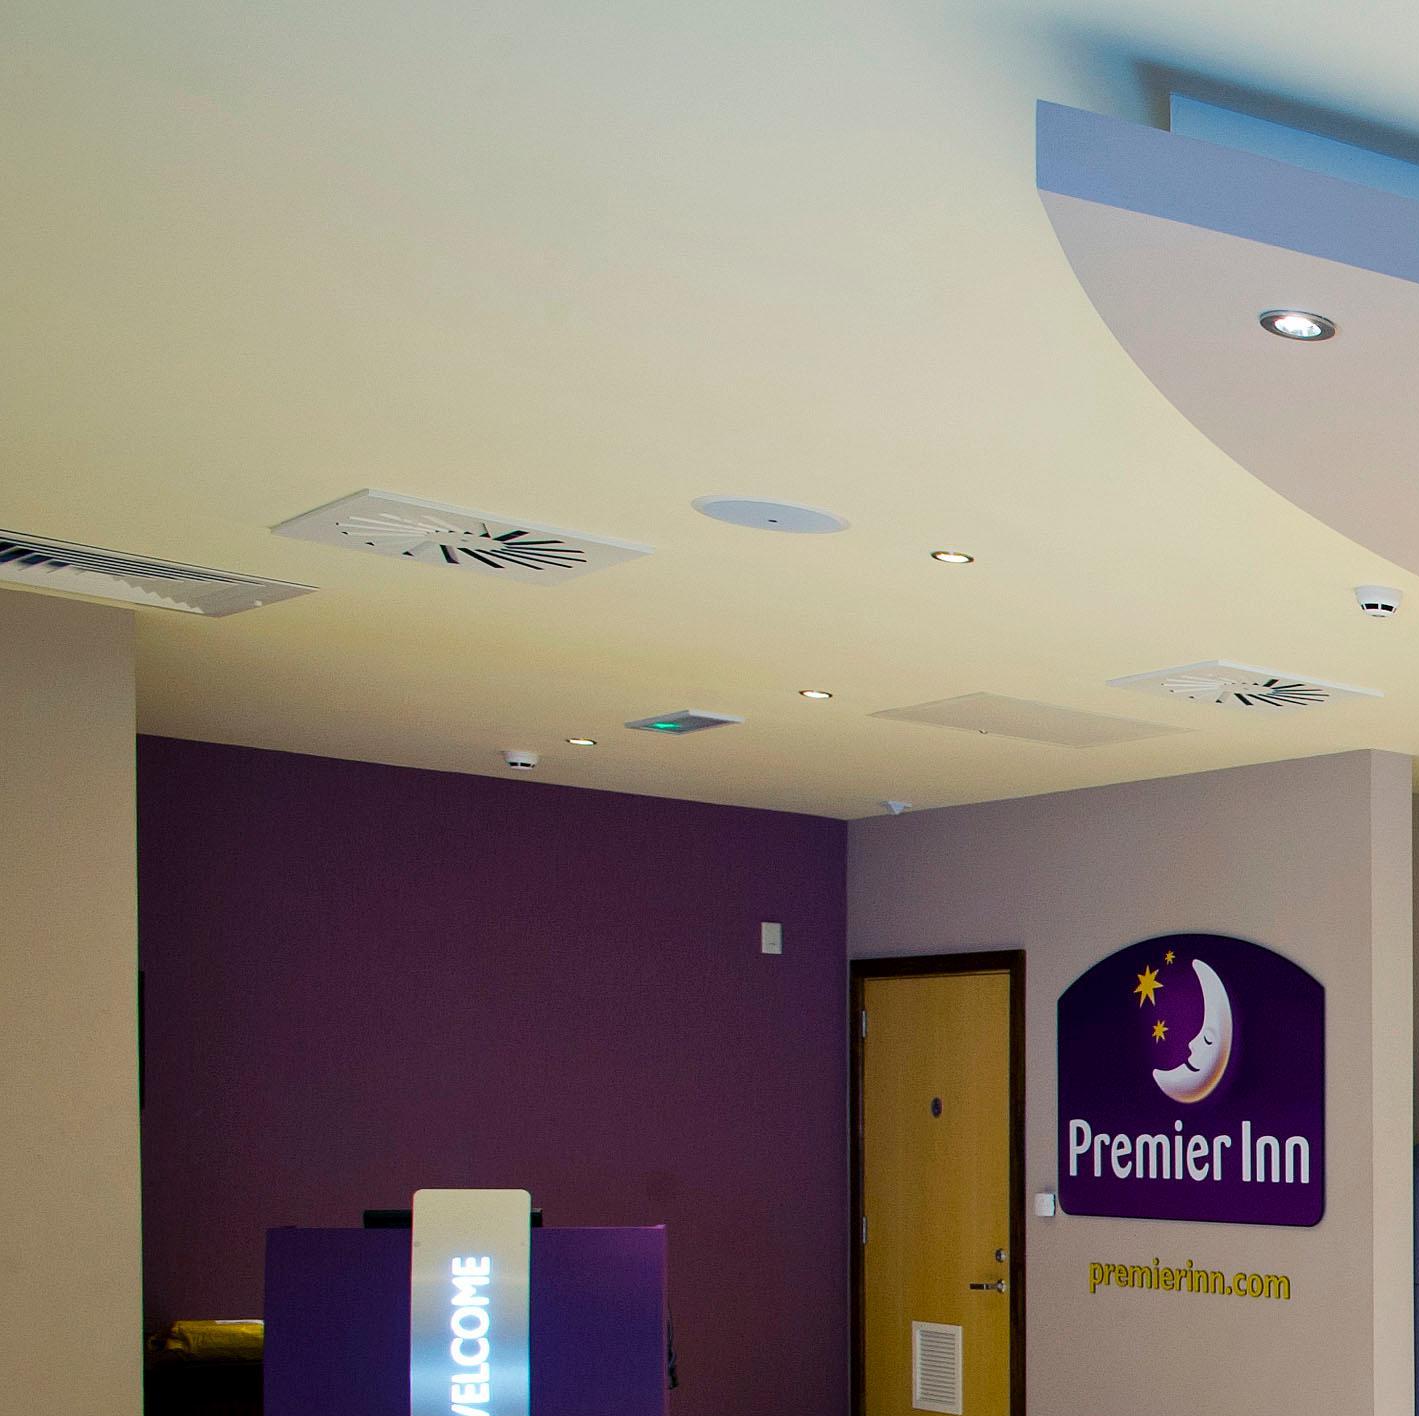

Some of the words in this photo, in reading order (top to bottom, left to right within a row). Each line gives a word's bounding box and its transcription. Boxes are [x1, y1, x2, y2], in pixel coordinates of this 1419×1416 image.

[1069, 1118, 1232, 1182] Premier
[1241, 1120, 1310, 1184] Inn
[1088, 1257, 1291, 1300] premierinn.com
